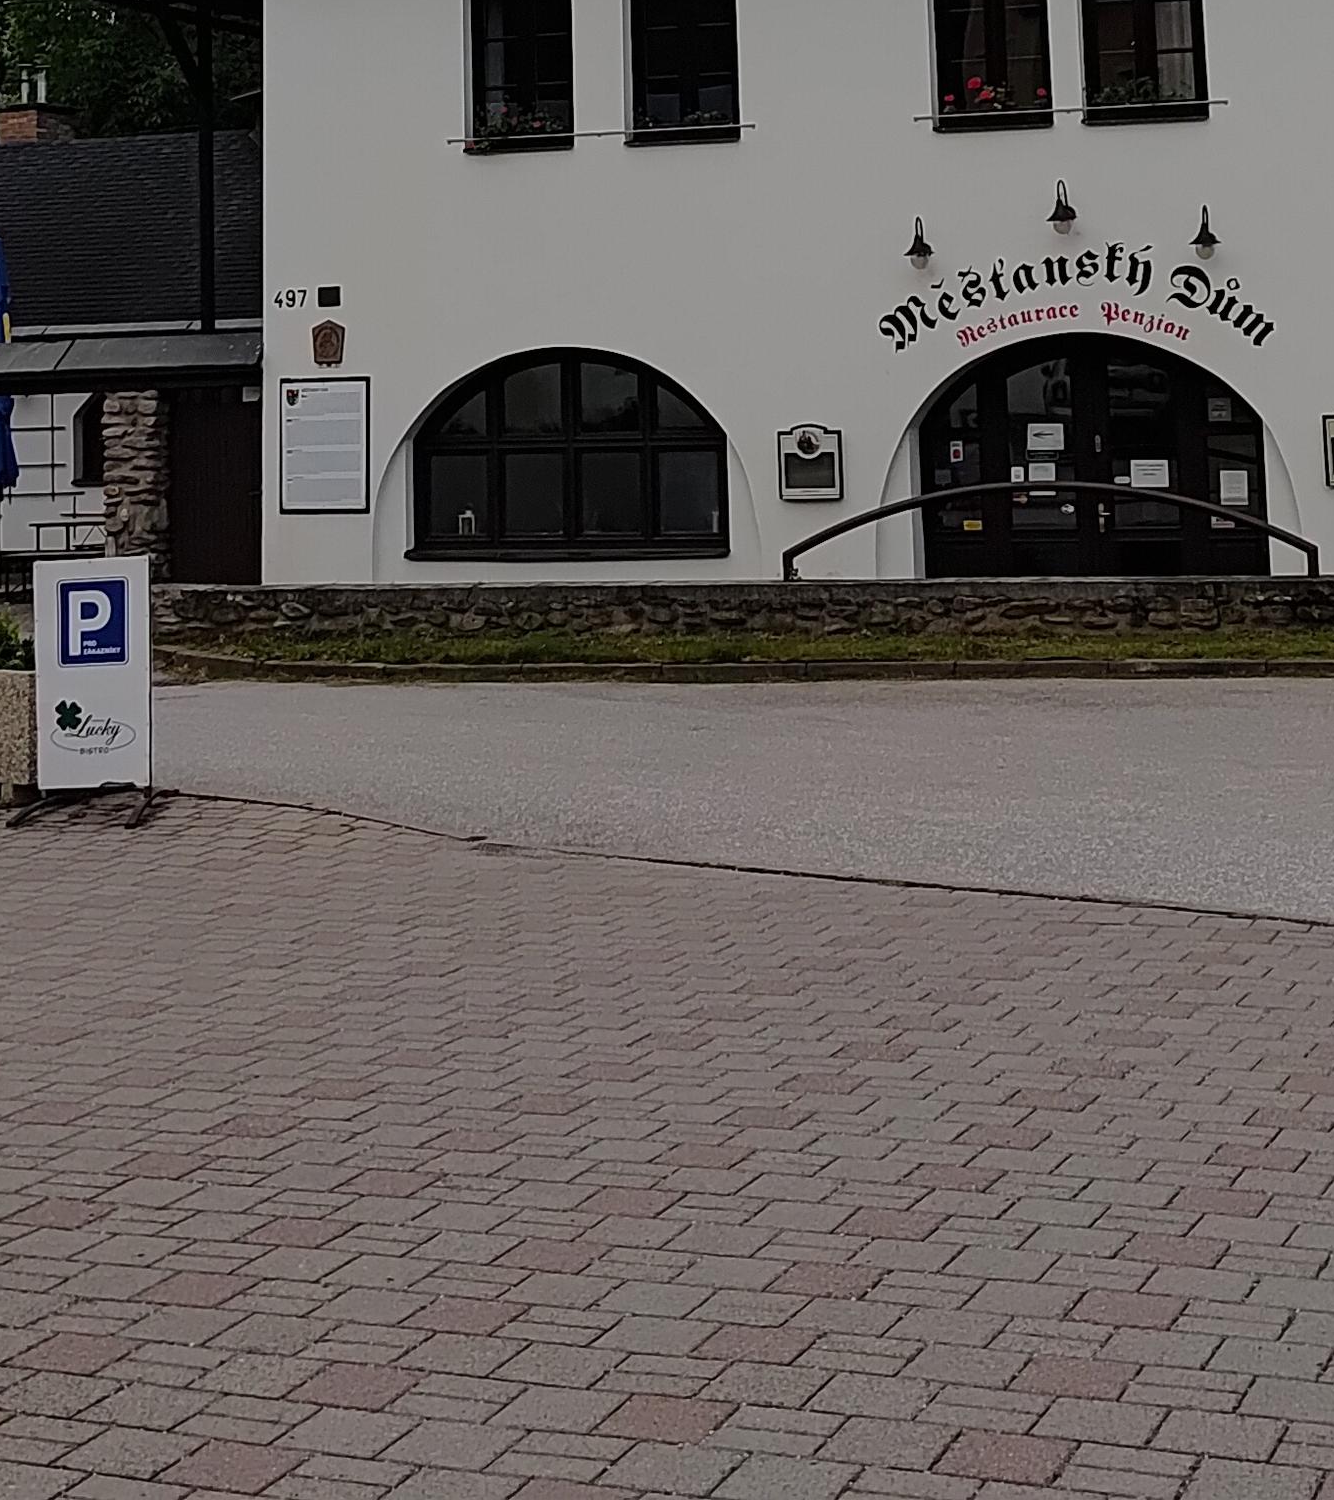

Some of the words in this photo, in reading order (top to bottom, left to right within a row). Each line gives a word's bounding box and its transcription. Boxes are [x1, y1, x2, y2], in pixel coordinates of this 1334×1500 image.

[274, 289, 307, 308] 497
[1166, 265, 1275, 347] Dům
[956, 304, 1080, 348] Restaurace
[1101, 302, 1191, 341] Penzion
[68, 590, 112, 656] P
[65, 714, 122, 746] Lucky
[79, 747, 109, 755] BISTRO
